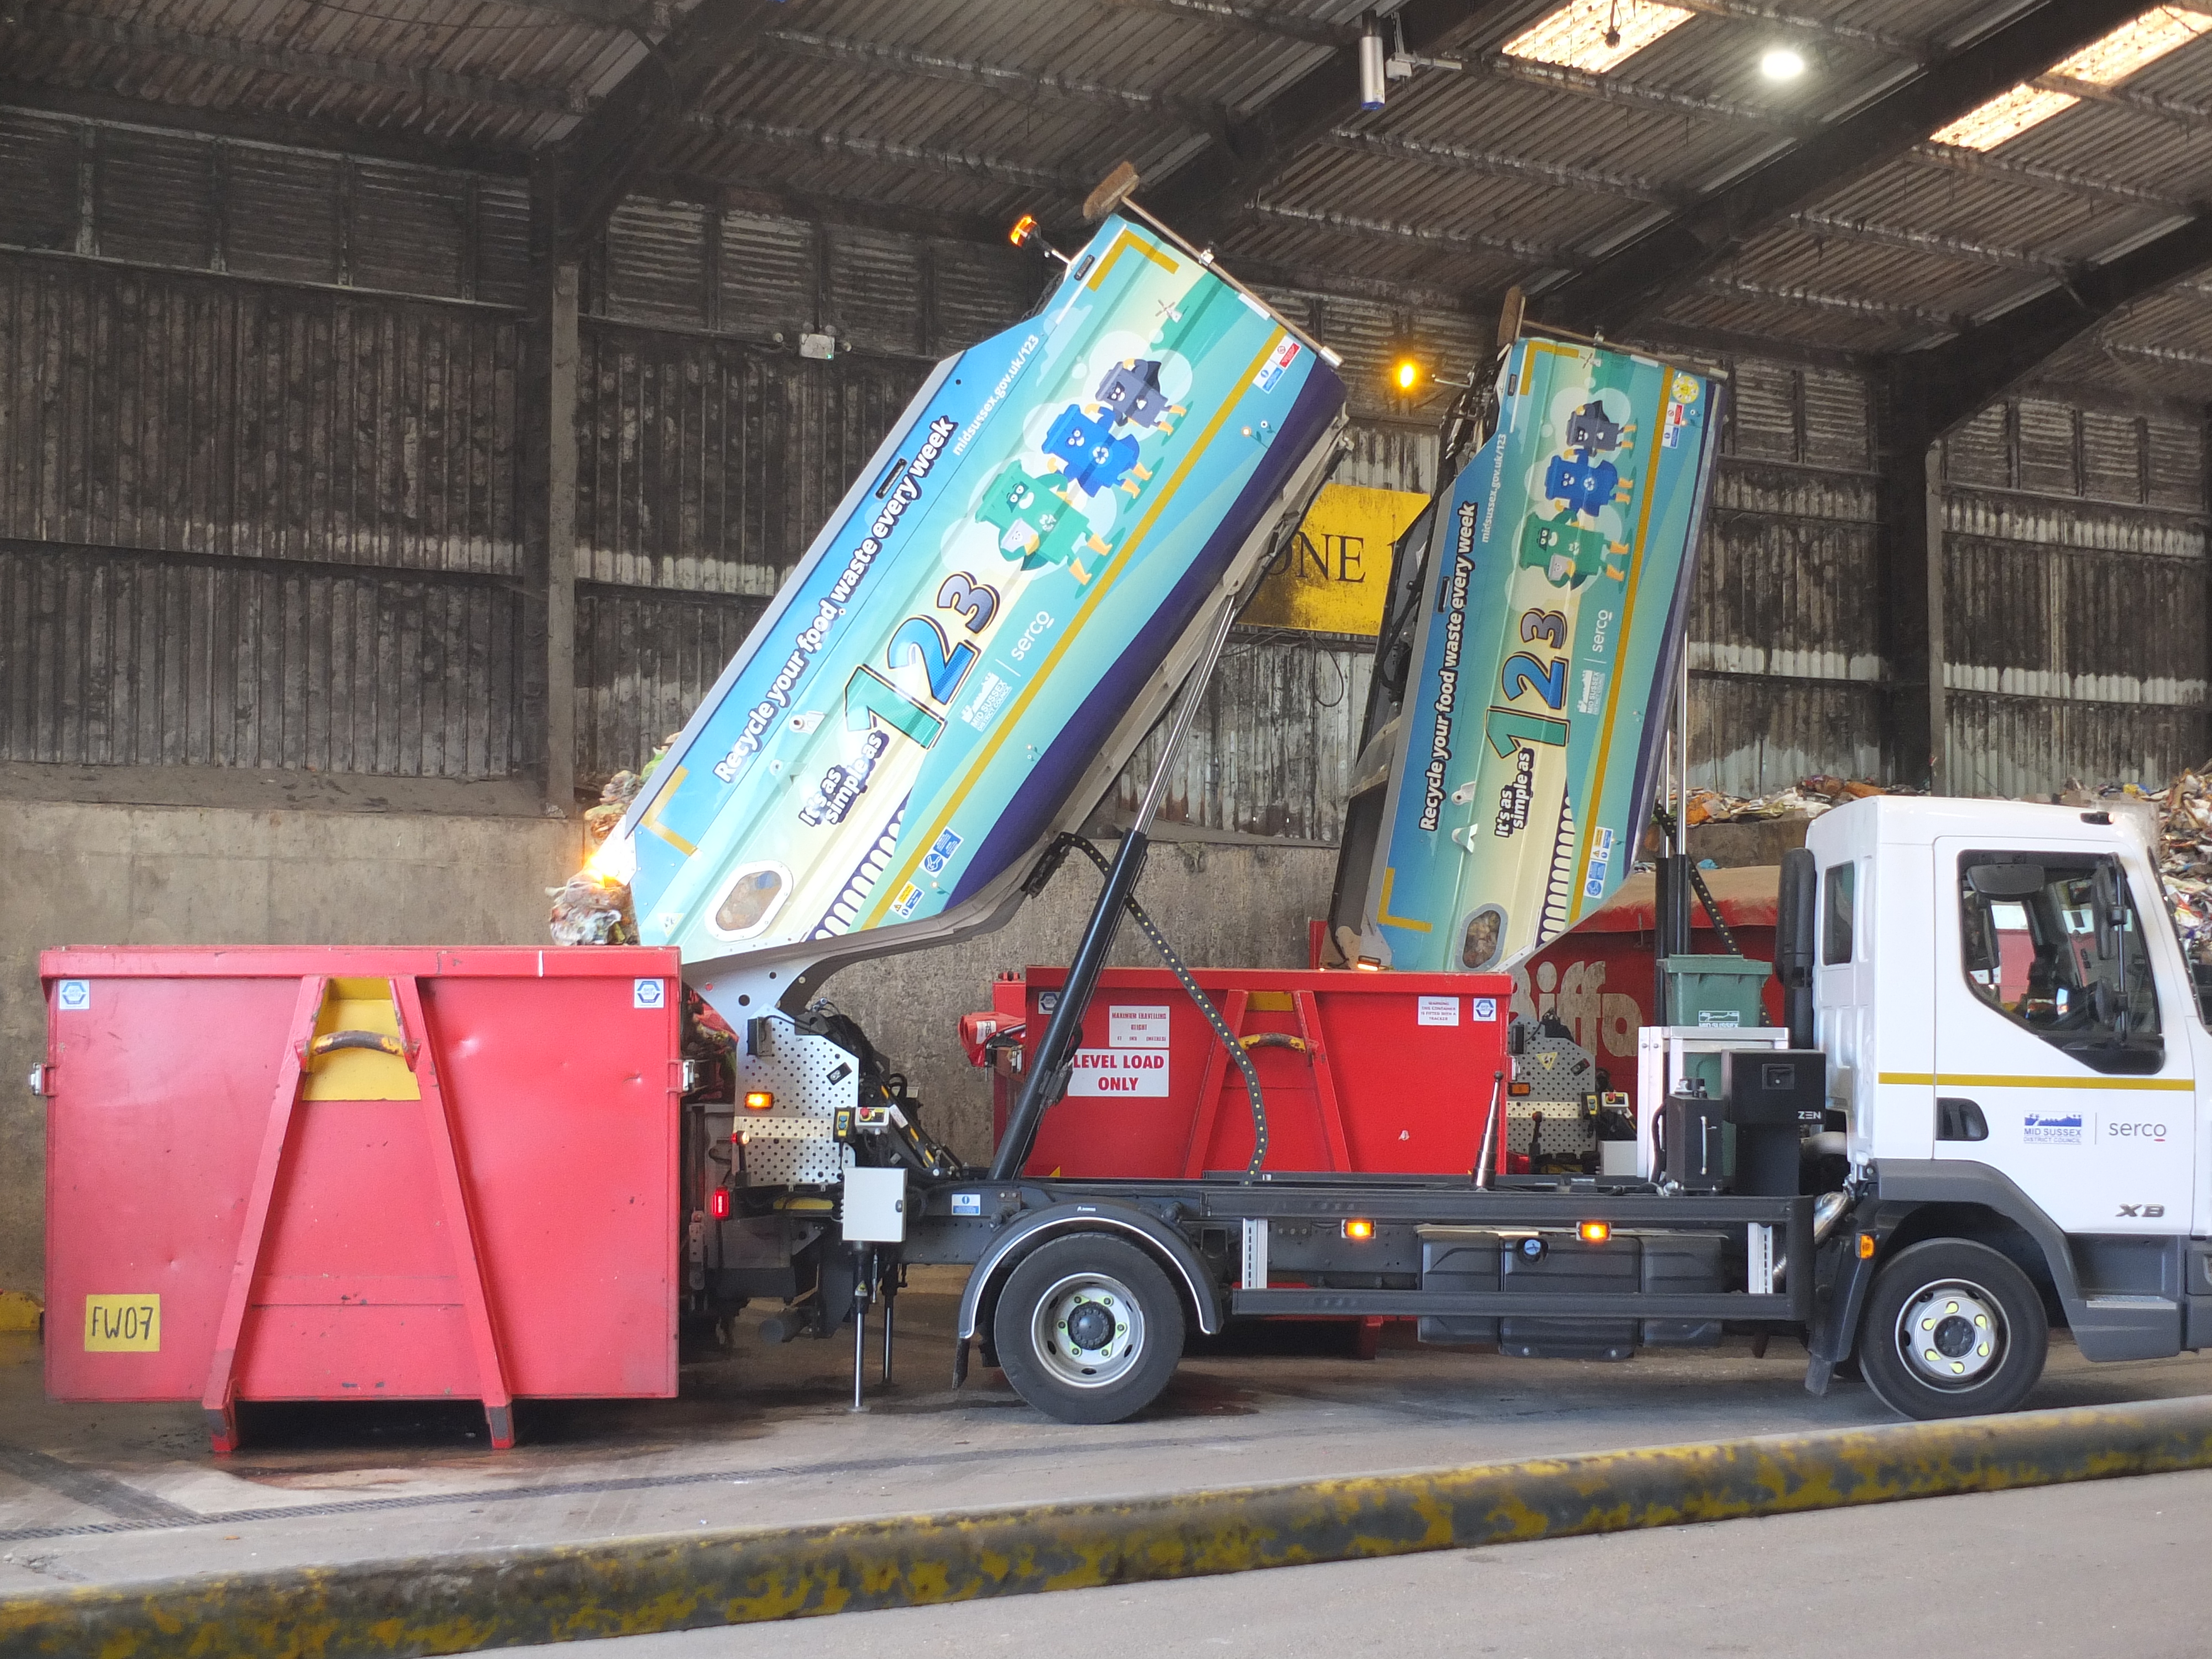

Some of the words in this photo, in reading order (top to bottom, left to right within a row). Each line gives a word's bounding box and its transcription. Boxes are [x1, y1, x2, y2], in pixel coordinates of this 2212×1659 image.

[953, 335, 1039, 456] midsussex.gov.uk/123
[1458, 502, 1477, 554] week
[713, 701, 776, 782] Recycle
[766, 649, 807, 707] your
[796, 598, 839, 654] food
[830, 538, 880, 603] waste
[872, 475, 920, 538] every
[908, 416, 956, 477] week
[1451, 555, 1474, 609] every
[1011, 611, 1053, 660] serco
[1444, 612, 1464, 667] waste
[1592, 609, 1612, 653] serco
[971, 711, 984, 727] MID
[981, 680, 1007, 712] SUSSEX
[1435, 669, 1457, 713] food
[1589, 672, 1600, 701] SUSSEX
[1432, 714, 1451, 760] your
[825, 758, 869, 825] simple
[862, 732, 886, 759] as
[1518, 751, 1532, 772] as
[799, 792, 827, 827] It's
[821, 766, 842, 794] as
[1420, 760, 1445, 831] Recycle
[1500, 789, 1514, 810] as
[1511, 774, 1531, 829] simple
[1495, 811, 1511, 838] It's
[1073, 1054, 1118, 1069] LEVEL
[1123, 1055, 1165, 1069] LOAD
[1098, 1076, 1139, 1091] ONLY
[1797, 1111, 1822, 1120] ZEN
[2043, 1128, 2081, 1136] SUSSEX
[2109, 1123, 2167, 1140] serco
[2115, 1203, 2165, 1218] XB
[92, 1306, 154, 1340] FW07
